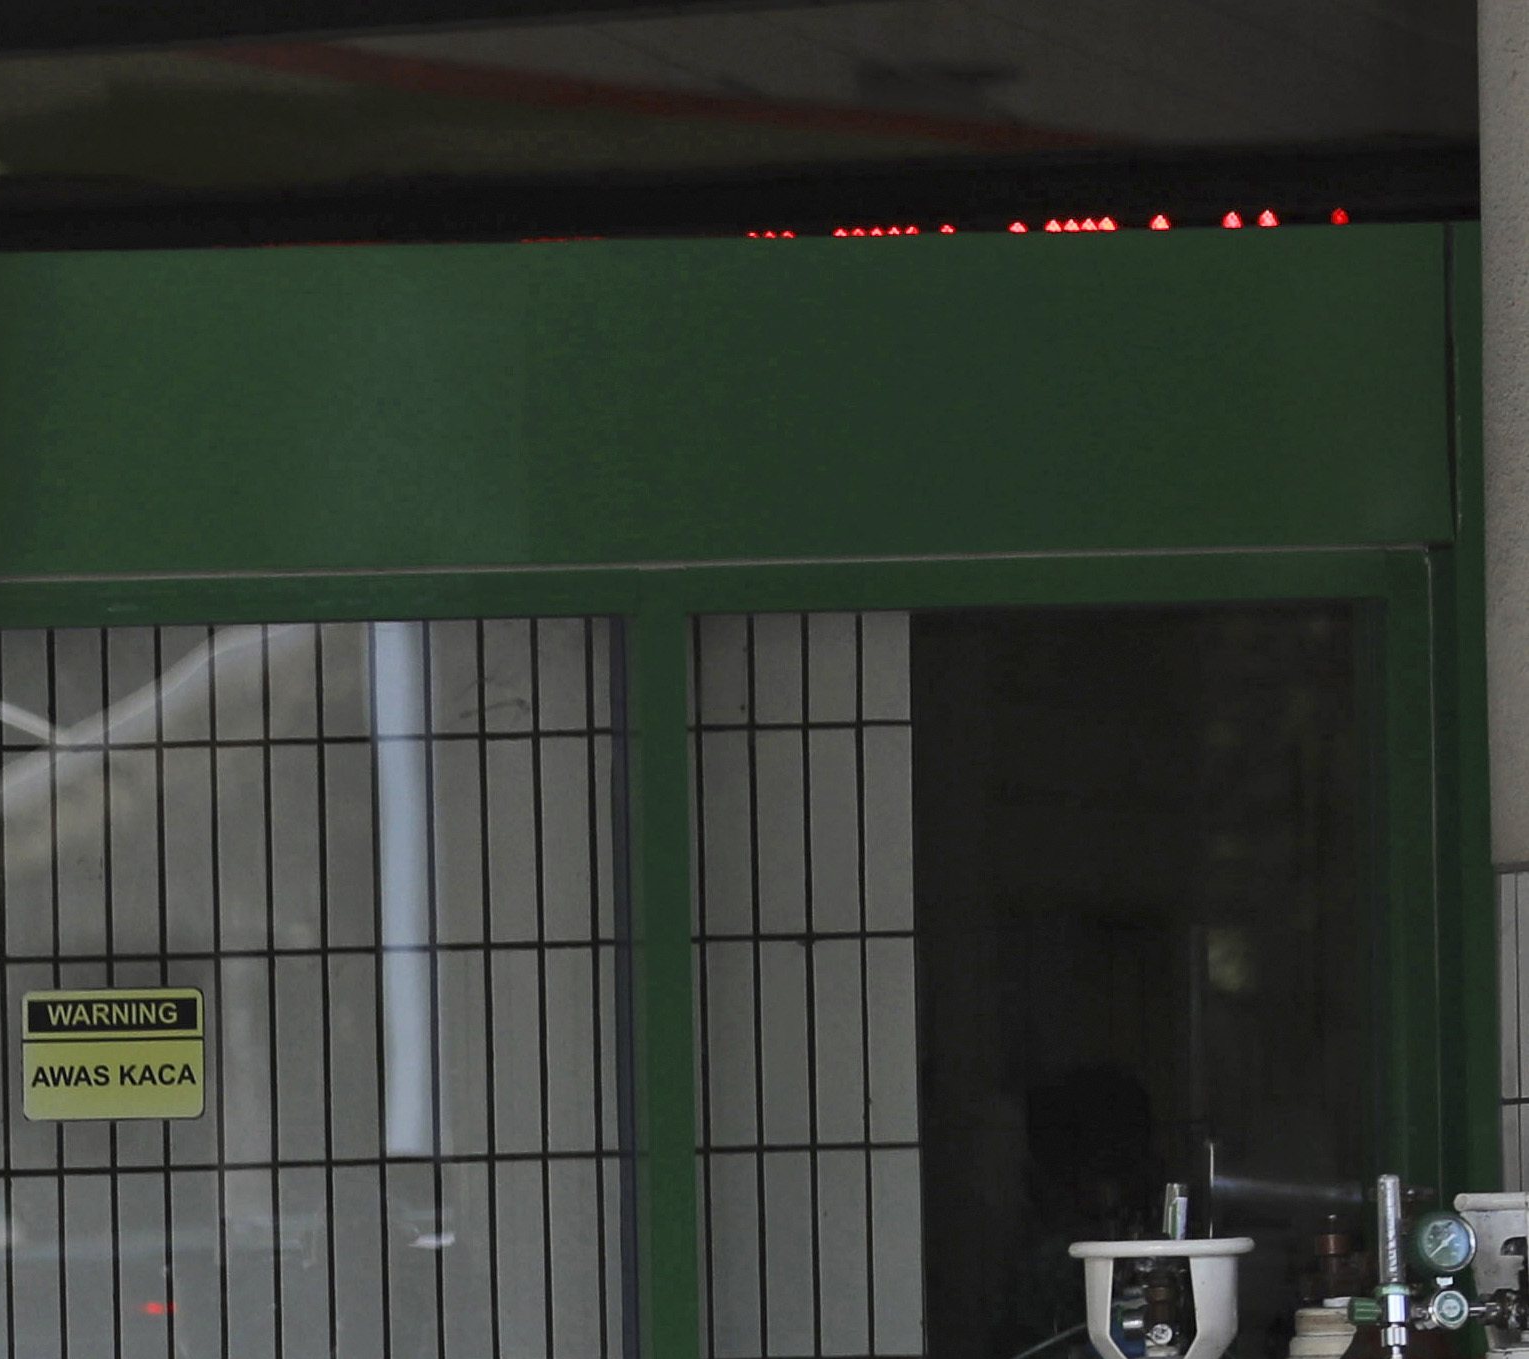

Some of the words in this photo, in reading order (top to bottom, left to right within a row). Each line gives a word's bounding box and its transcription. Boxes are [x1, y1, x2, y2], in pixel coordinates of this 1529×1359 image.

[47, 1002, 177, 1026] WARNING
[31, 1065, 110, 1088] AWAS
[119, 1063, 196, 1086] KACA
